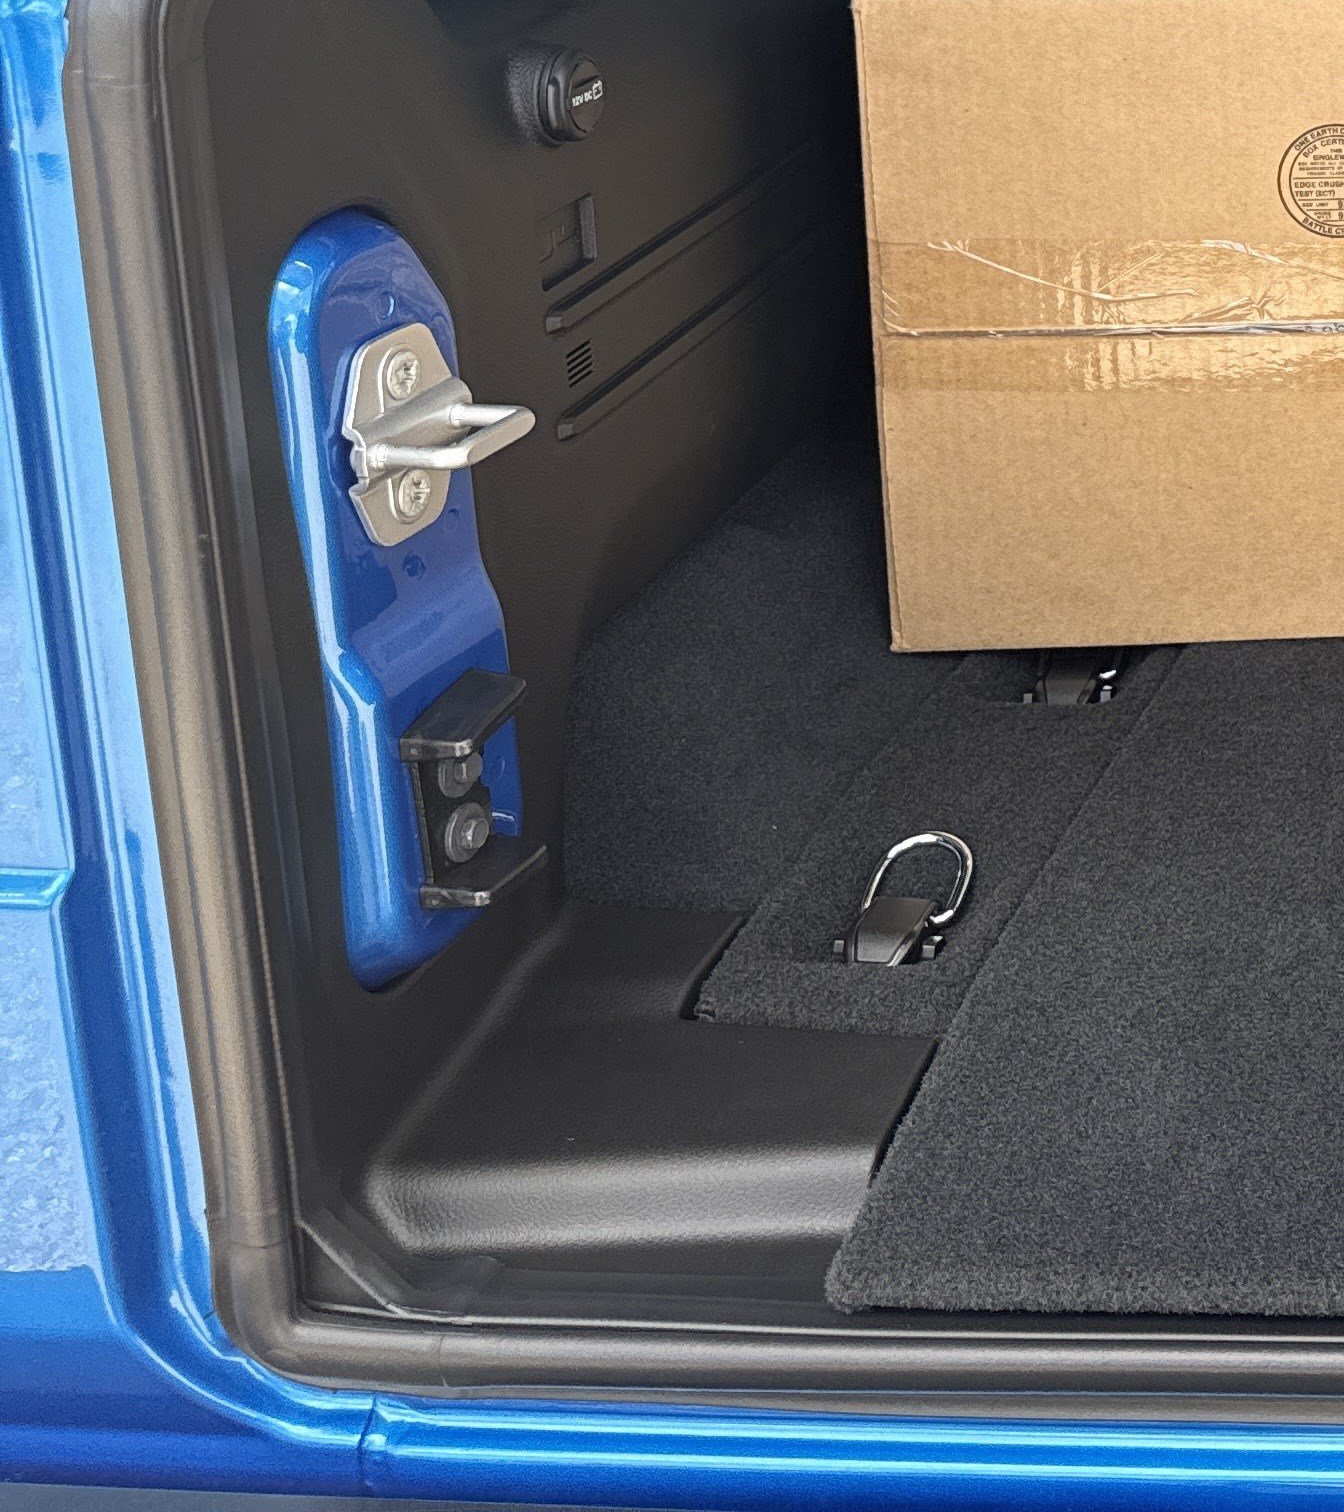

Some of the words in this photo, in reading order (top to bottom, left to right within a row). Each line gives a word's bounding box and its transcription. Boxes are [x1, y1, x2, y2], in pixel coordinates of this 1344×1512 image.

[1294, 137, 1310, 151] ONE
[1311, 128, 1338, 139] EARTH
[1303, 144, 1318, 158] BOX
[1302, 216, 1333, 234] BATTLE
